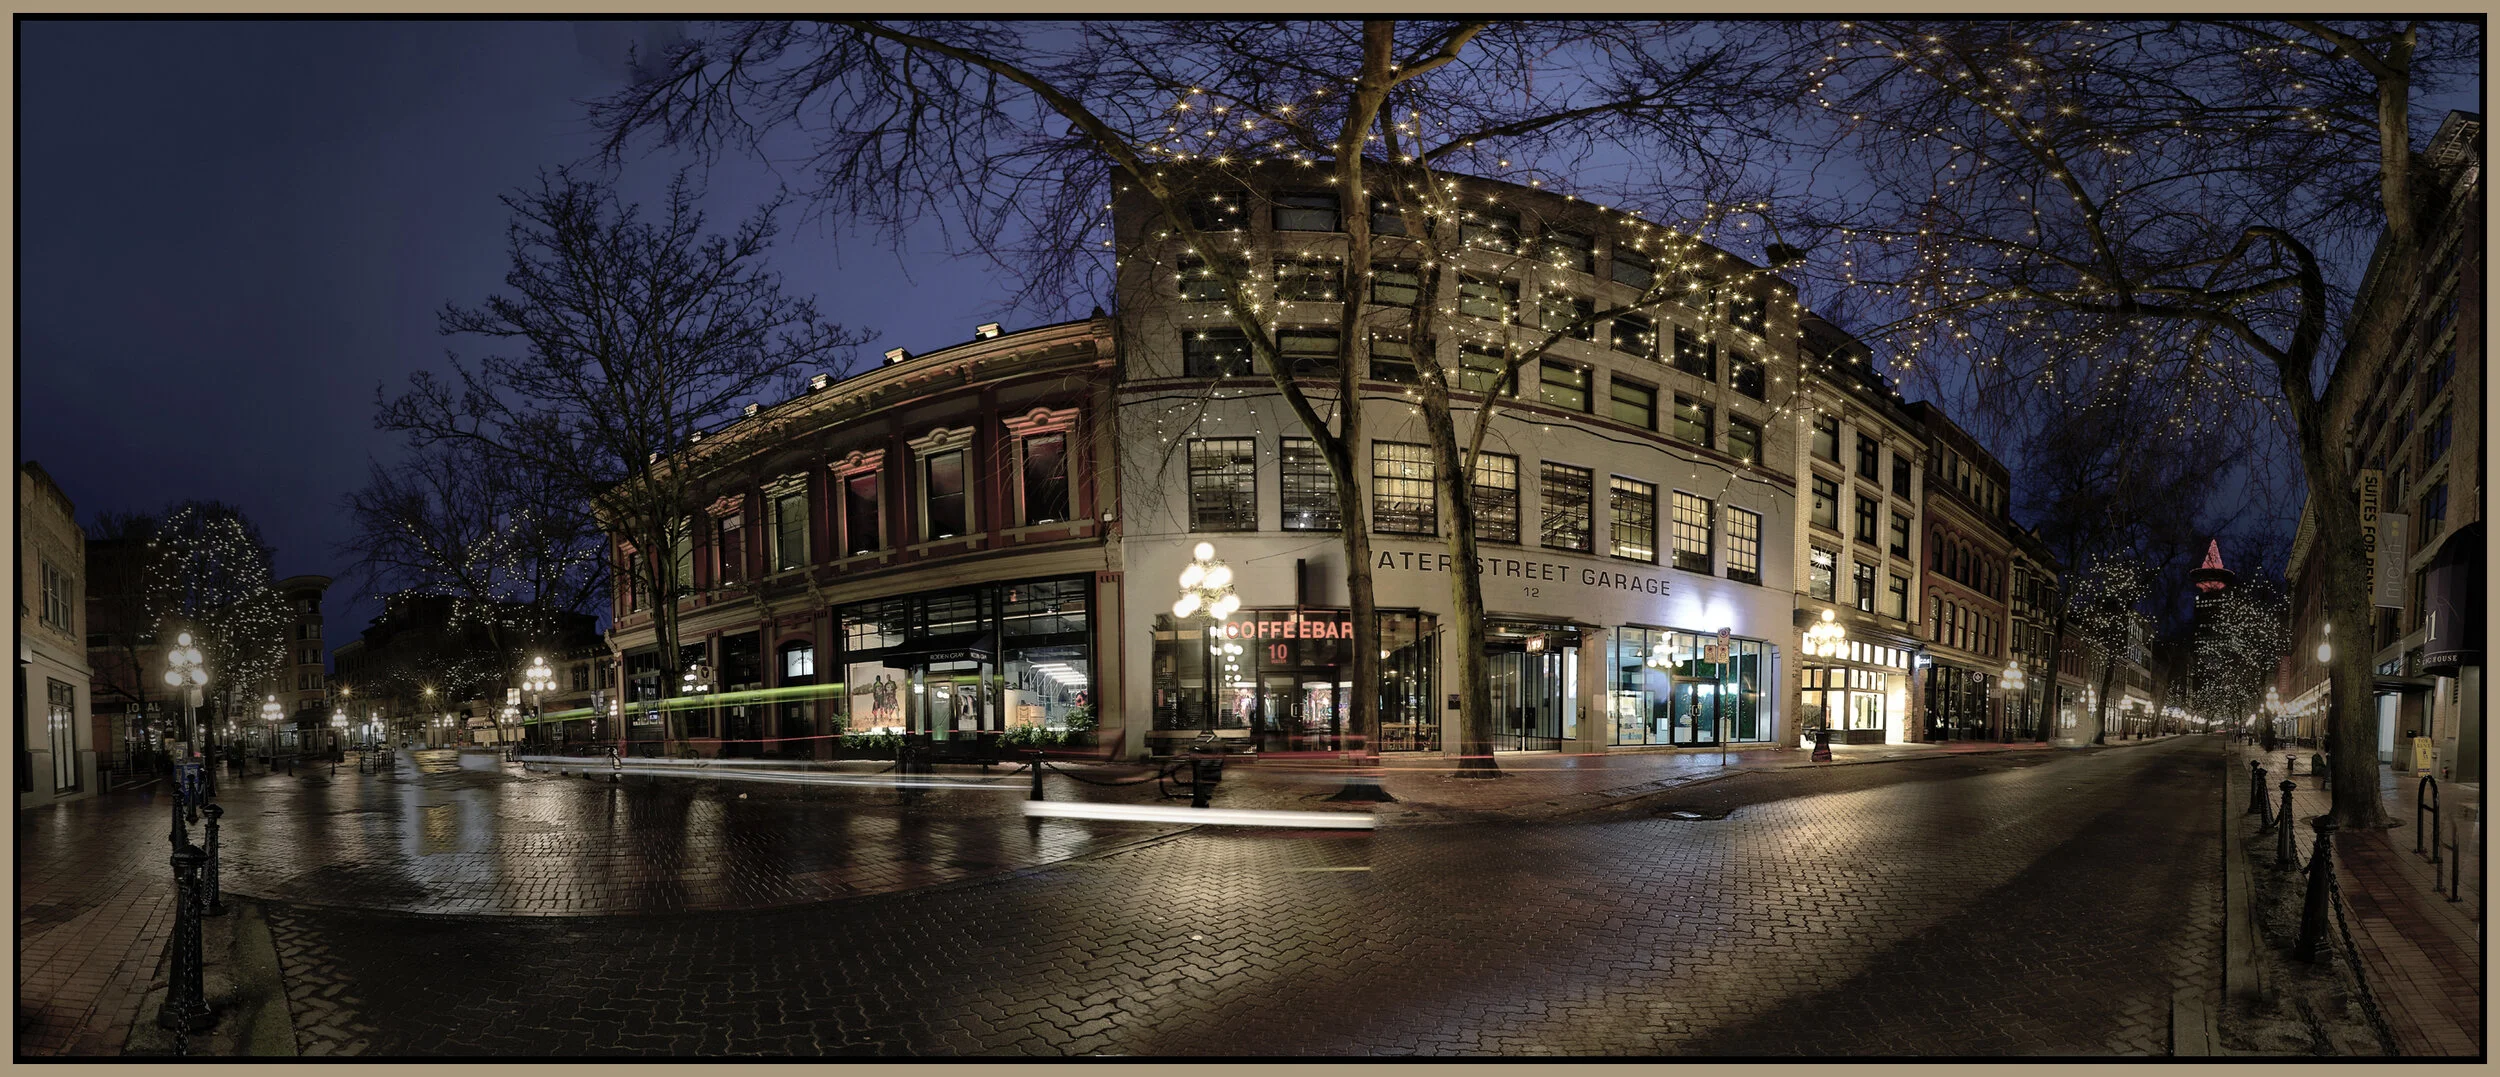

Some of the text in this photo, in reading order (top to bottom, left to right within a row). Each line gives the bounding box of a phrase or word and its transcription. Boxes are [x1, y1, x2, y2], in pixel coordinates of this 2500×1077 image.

[2363, 476, 2378, 522] SUITES
[1369, 550, 1451, 572] ATER
[1581, 569, 1671, 597] GARAGE
[1523, 586, 1540, 598] 12
[1268, 643, 1288, 660] 10
[126, 702, 161, 714] LOAL
